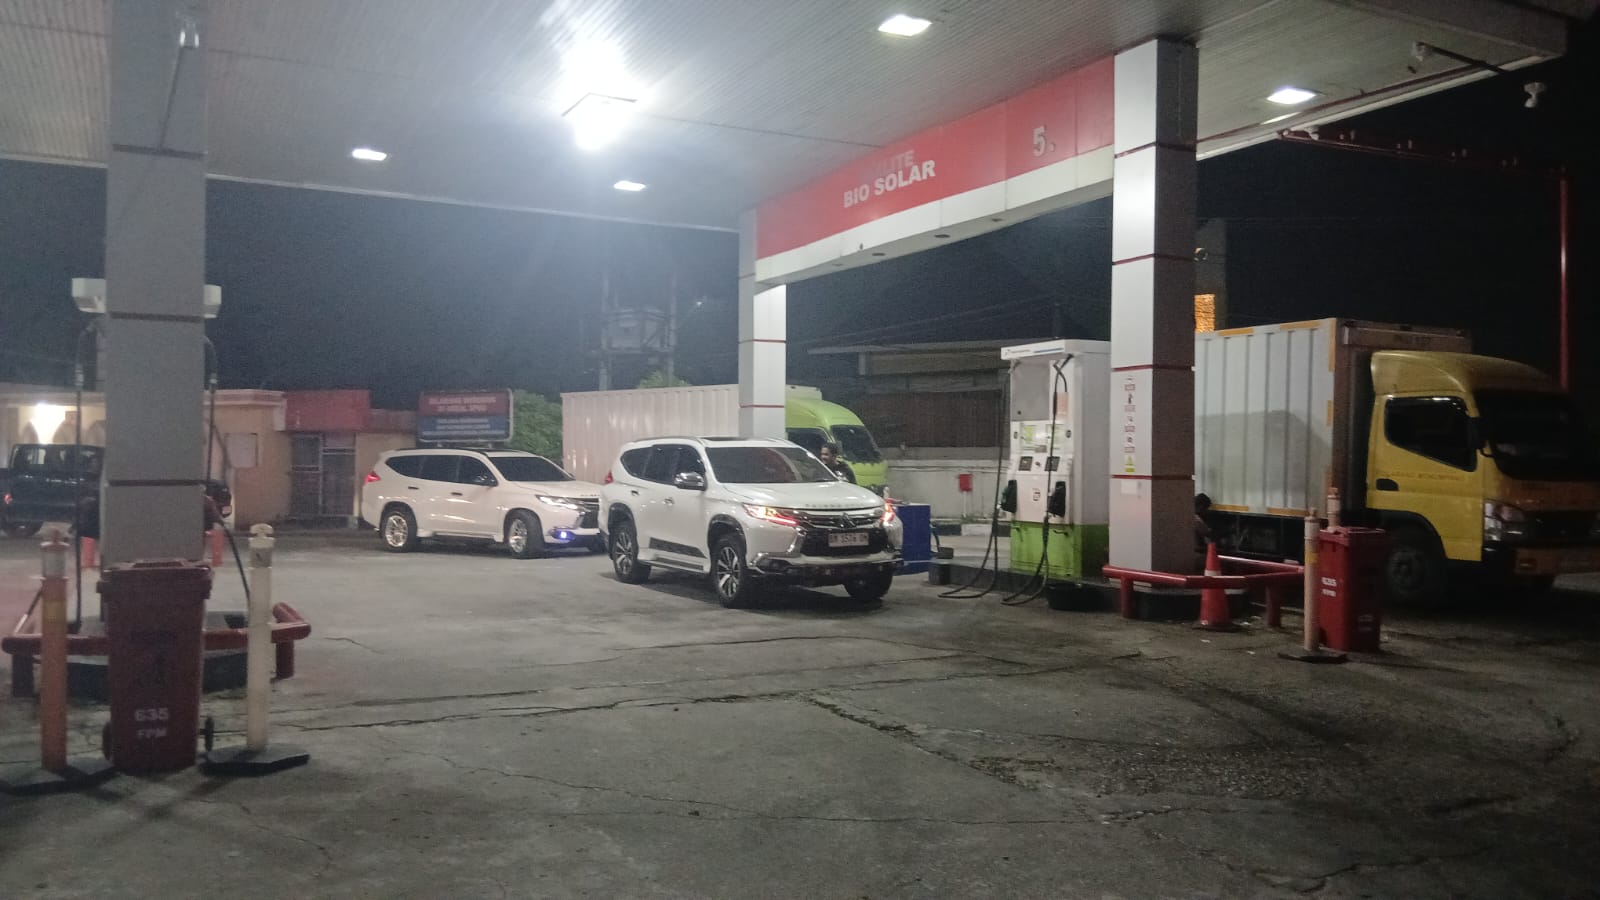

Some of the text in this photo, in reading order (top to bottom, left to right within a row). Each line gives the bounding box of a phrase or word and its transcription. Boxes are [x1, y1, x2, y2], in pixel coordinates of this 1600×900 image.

[843, 159, 936, 208] BIO SOLAR
[135, 707, 169, 721] 635
